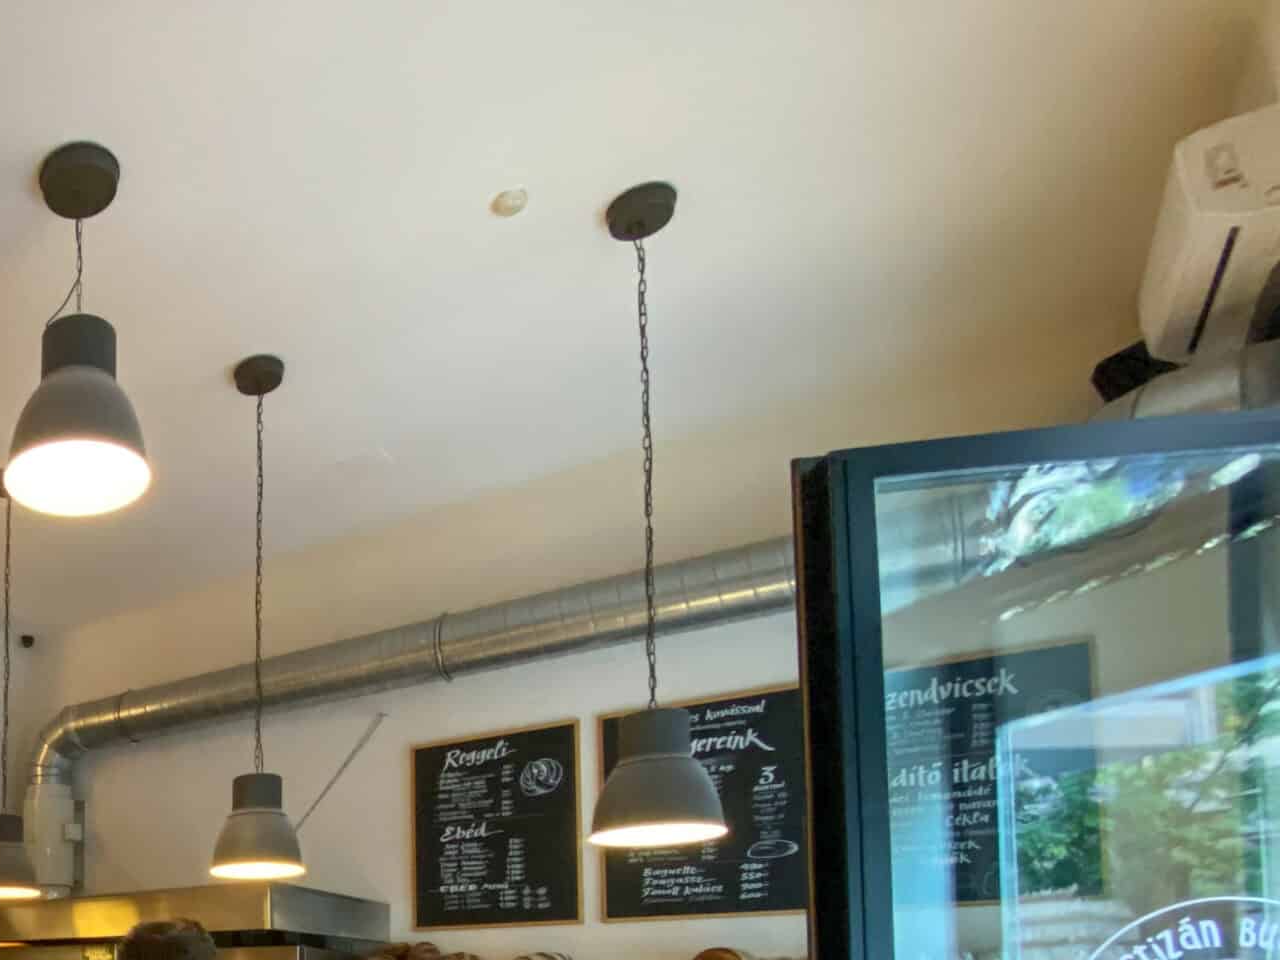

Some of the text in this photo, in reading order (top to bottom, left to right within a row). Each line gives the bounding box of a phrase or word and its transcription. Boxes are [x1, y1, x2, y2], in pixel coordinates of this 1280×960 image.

[885, 667, 1019, 711] zendvicsek
[442, 739, 515, 770] Reggeli
[688, 728, 776, 759] yereink
[758, 765, 778, 785] 3
[888, 761, 944, 787] dítő
[440, 822, 504, 842] Ebéd
